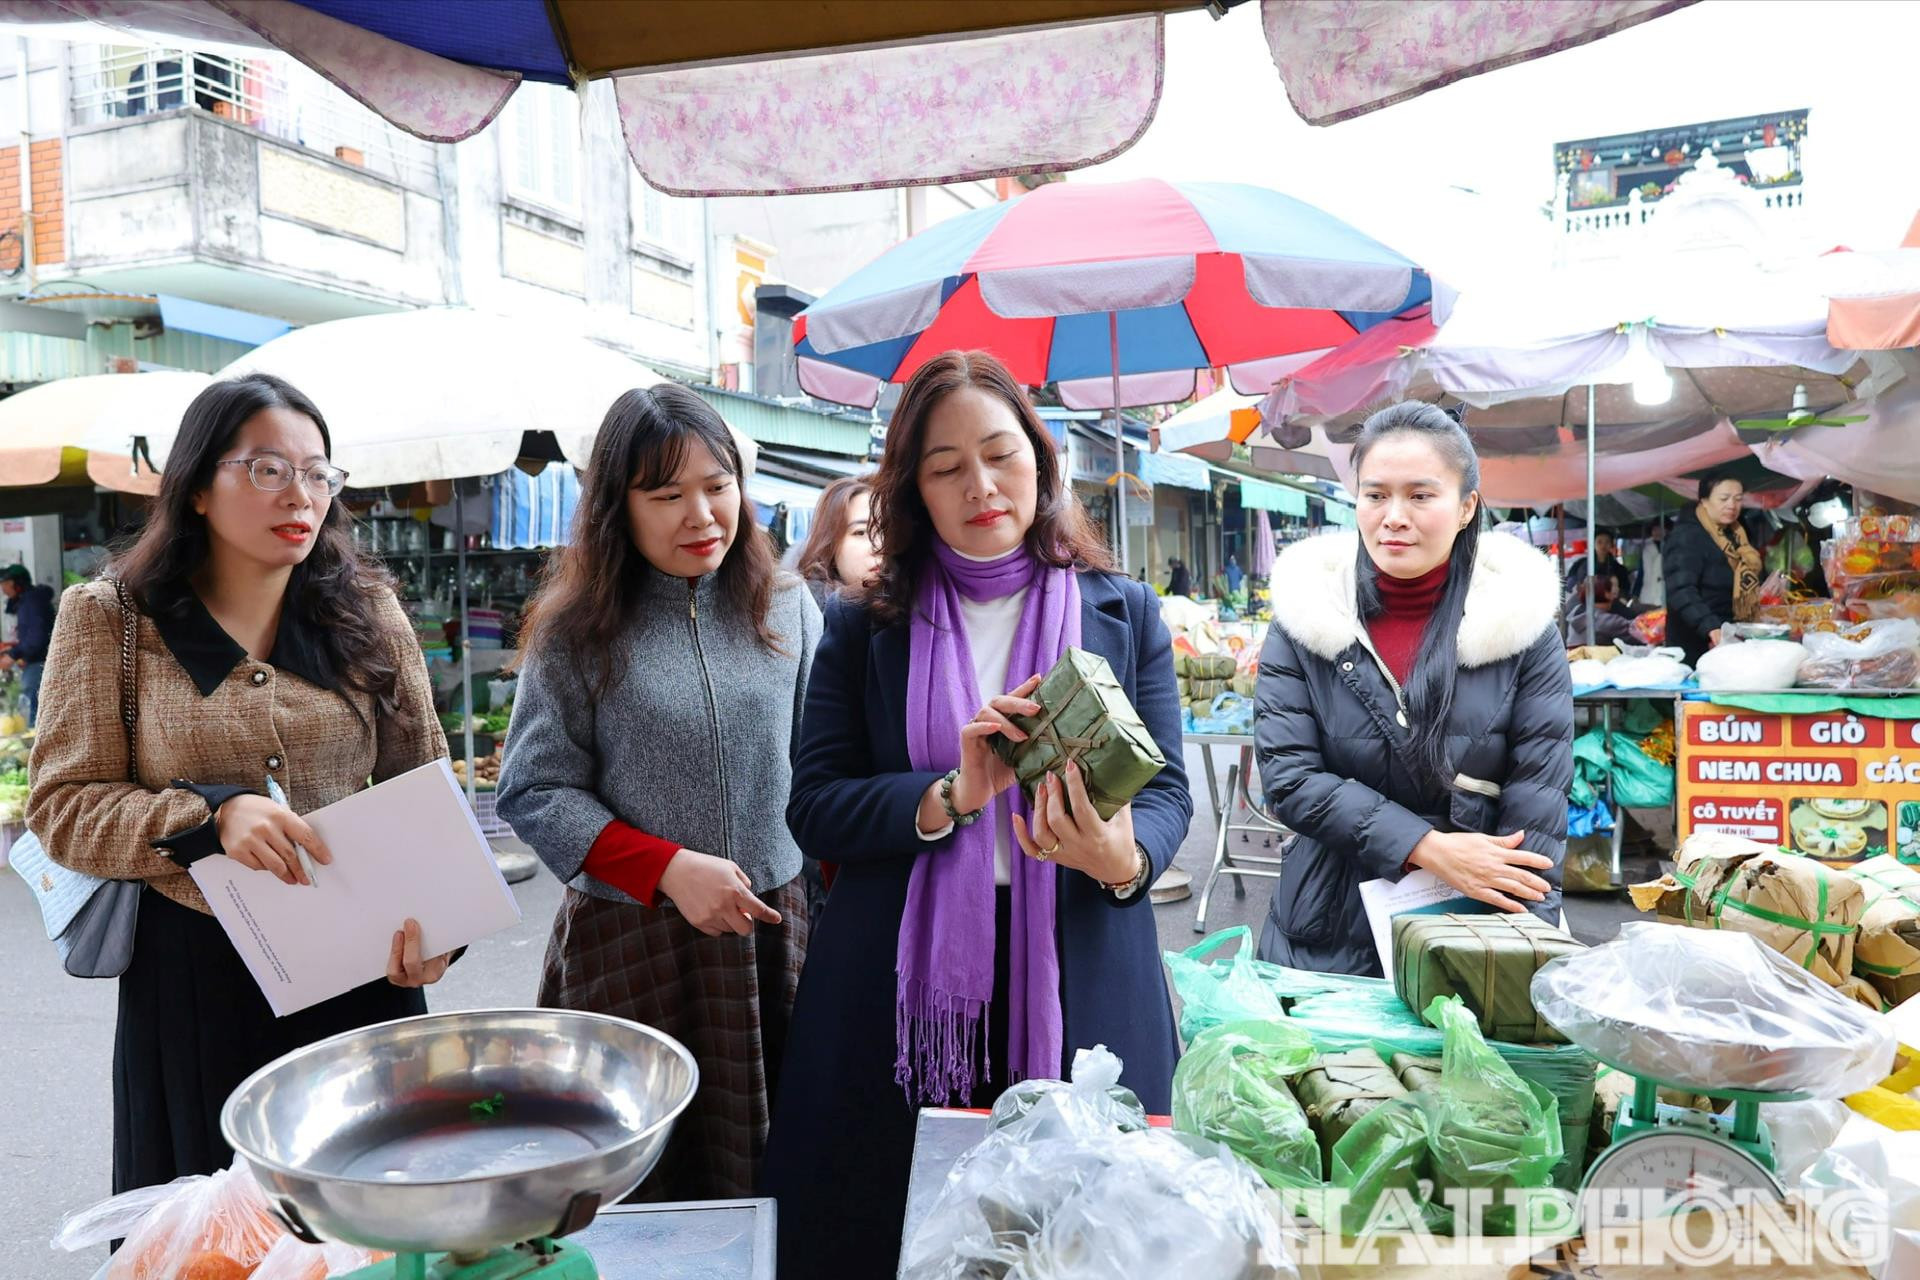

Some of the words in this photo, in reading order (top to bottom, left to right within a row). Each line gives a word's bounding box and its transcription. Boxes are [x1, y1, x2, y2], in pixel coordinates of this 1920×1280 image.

[1698, 714, 1763, 743] BÚN
[1809, 715, 1866, 744] GIÒ
[1698, 761, 1761, 781] NEM
[1766, 762, 1842, 783] CHUA
[1865, 755, 1920, 783] CÁC
[1693, 802, 1717, 819] CÔ
[1719, 799, 1777, 821] TUYẾT
